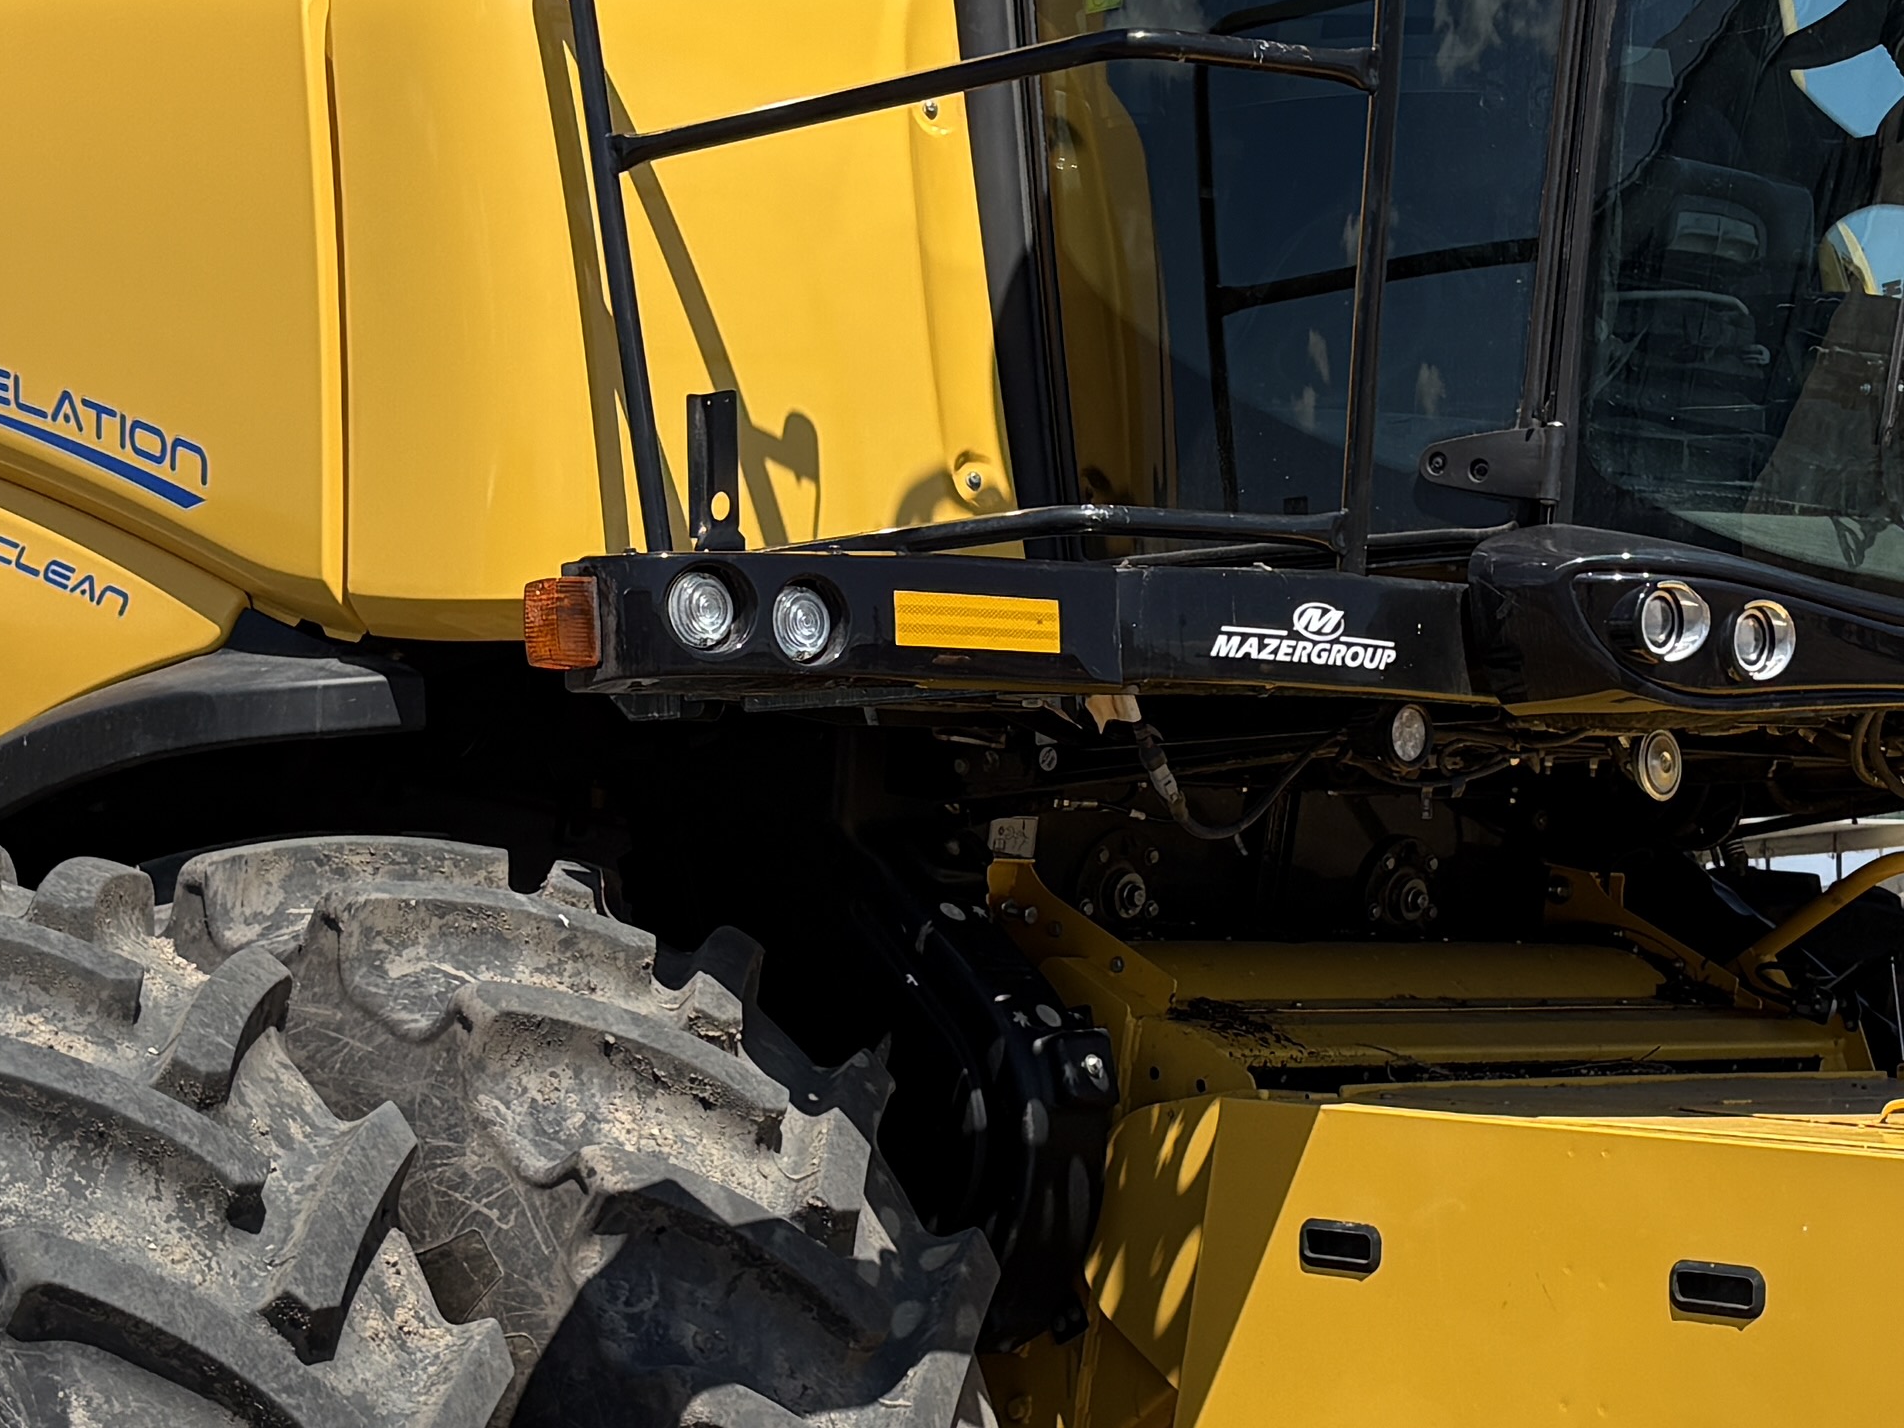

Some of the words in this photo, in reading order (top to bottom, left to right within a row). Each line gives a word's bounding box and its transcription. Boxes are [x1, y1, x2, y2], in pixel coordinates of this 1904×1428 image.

[137, 632, 278, 740] TWIN
[1210, 635, 1397, 670] MAZERGROUP
[103, 711, 319, 844] ROTOR
